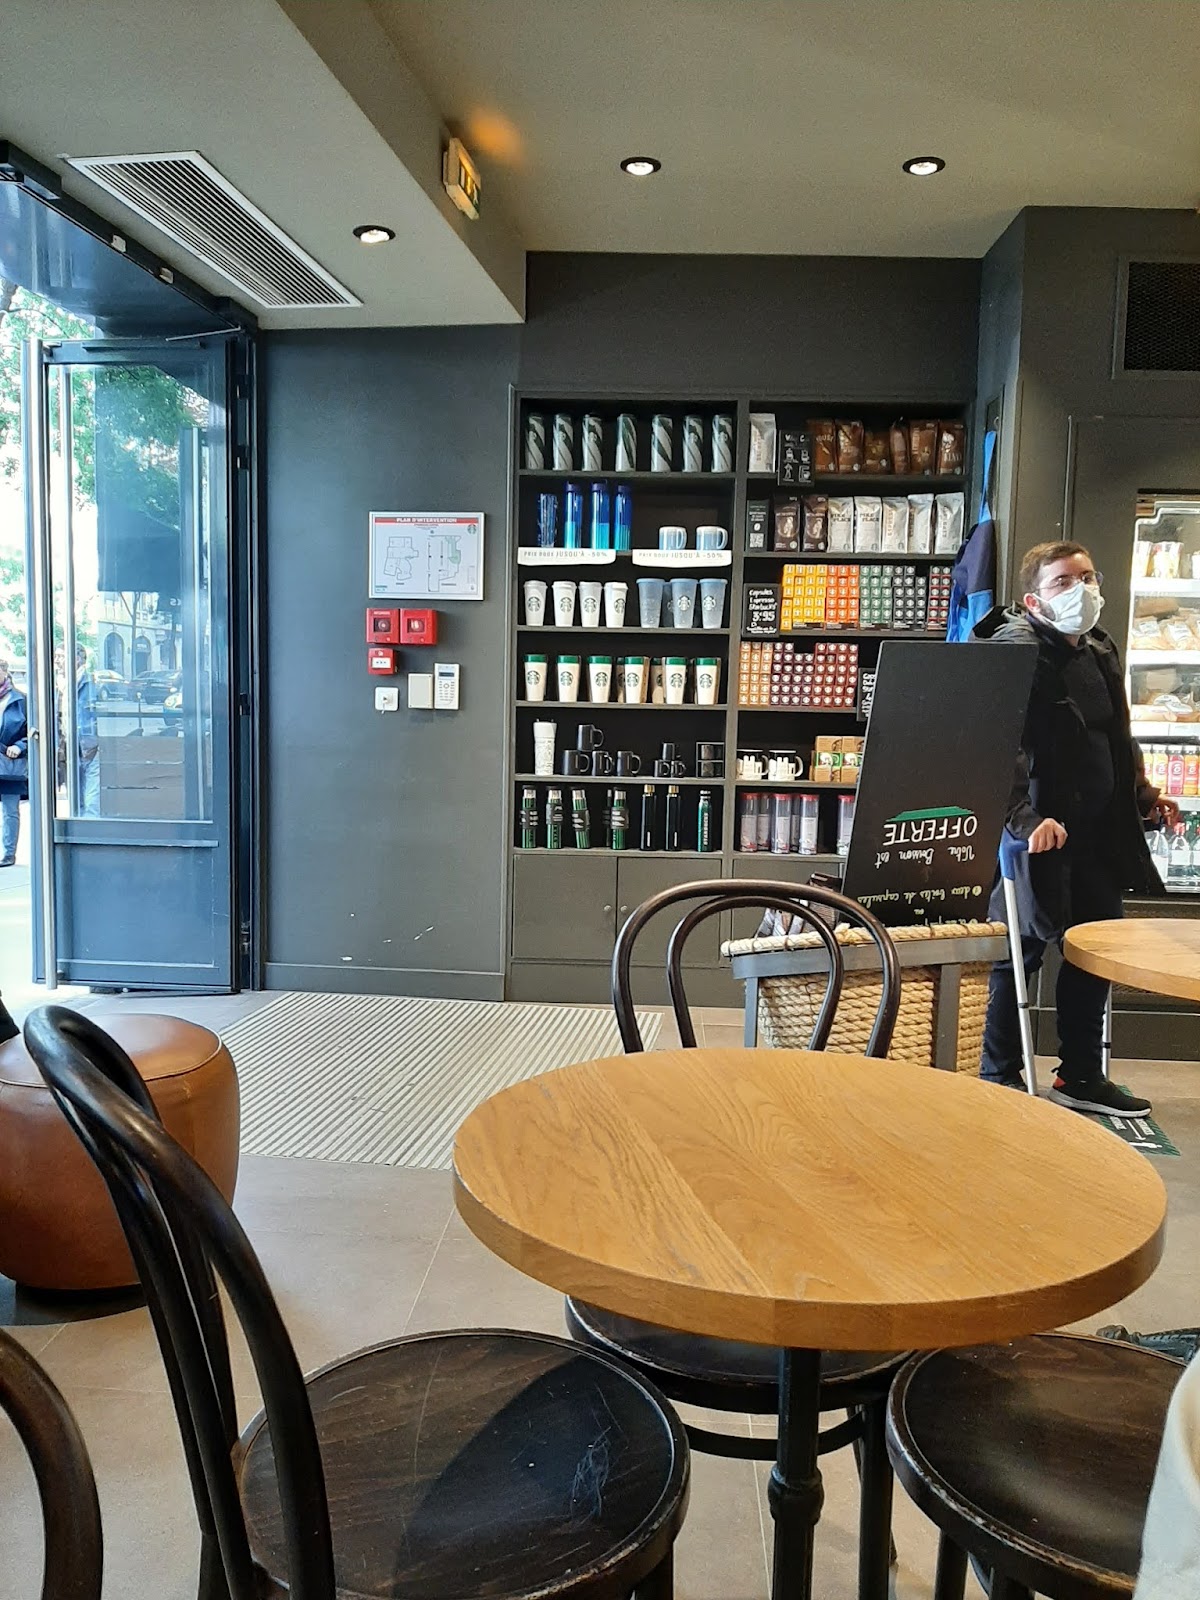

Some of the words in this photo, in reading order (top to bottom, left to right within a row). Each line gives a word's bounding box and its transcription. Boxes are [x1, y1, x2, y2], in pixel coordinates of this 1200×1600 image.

[883, 816, 978, 846] OFFERTE
[874, 851, 890, 869] est
[899, 848, 934, 865] Boisson
[948, 845, 975, 862] Votre
[857, 889, 899, 909] capsules
[903, 891, 916, 904] de
[952, 886, 969, 899] deux
